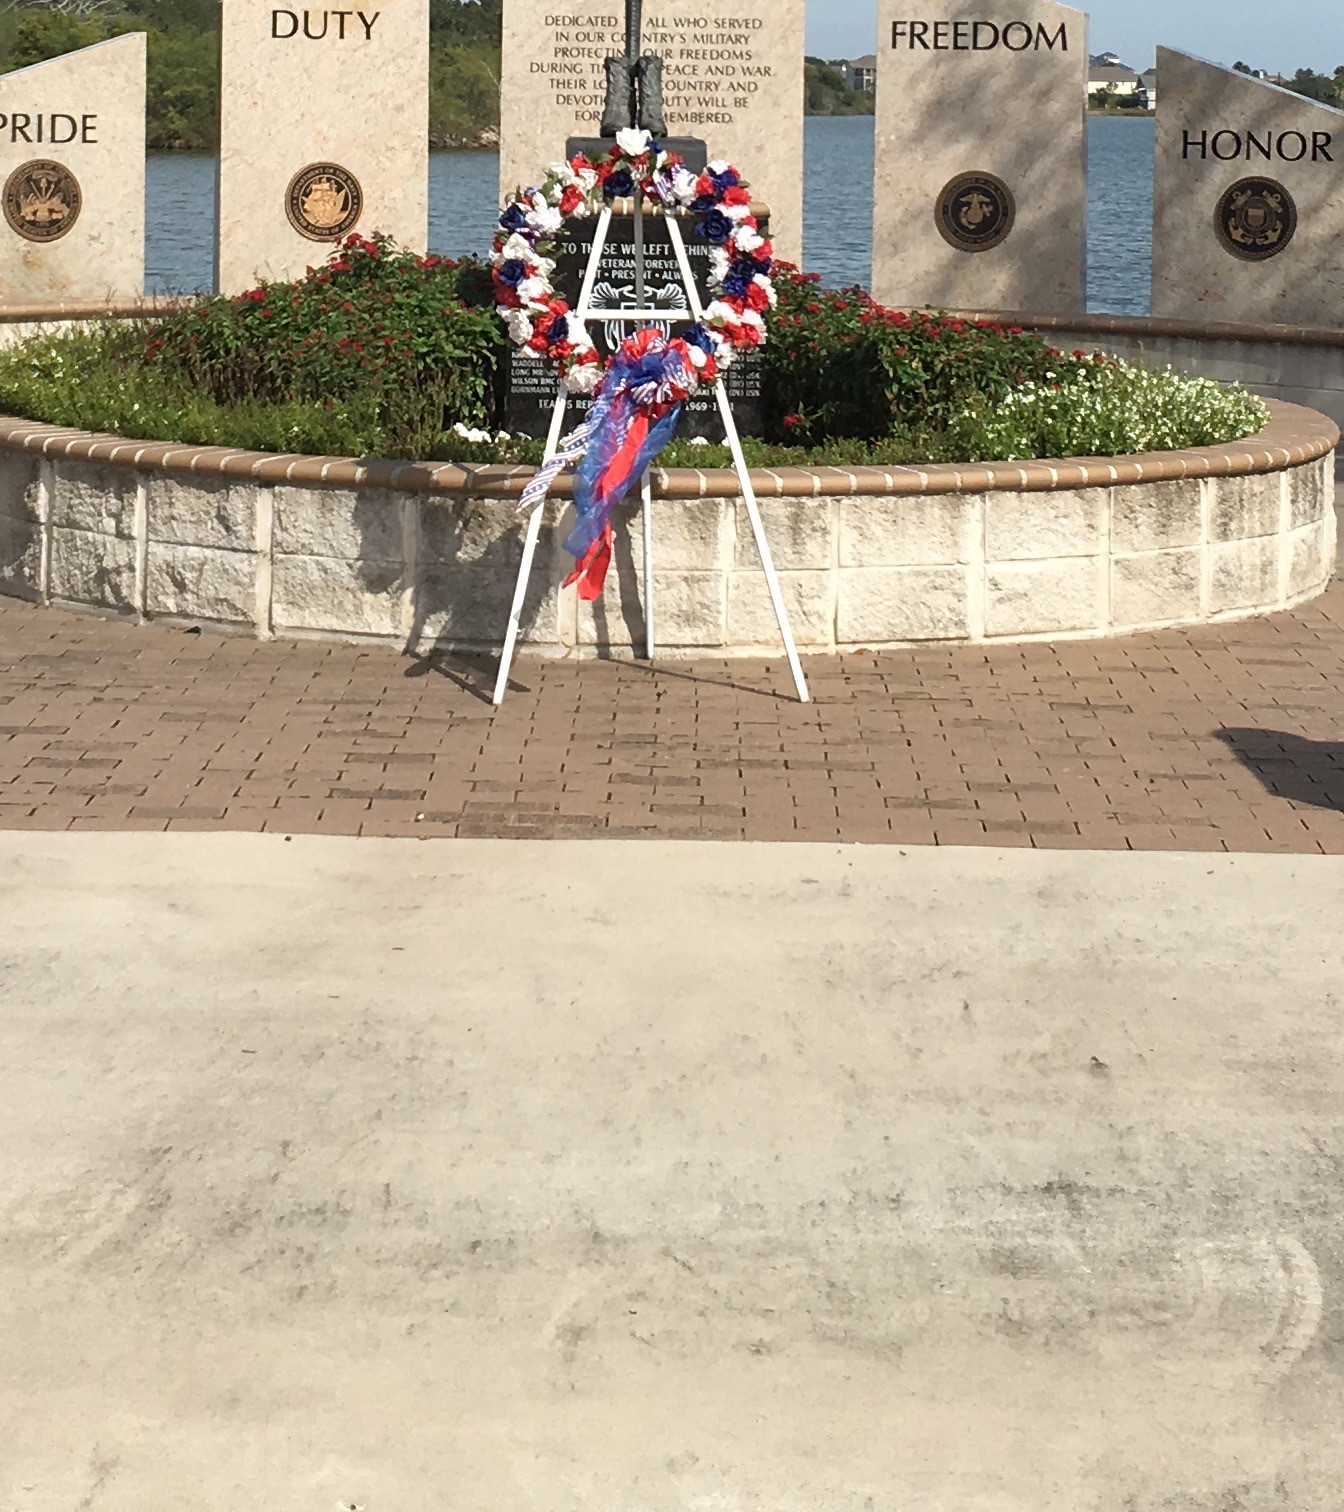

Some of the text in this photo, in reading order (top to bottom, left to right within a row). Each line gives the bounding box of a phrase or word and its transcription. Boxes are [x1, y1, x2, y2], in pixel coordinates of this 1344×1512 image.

[272, 9, 381, 41] DUTY
[545, 15, 763, 29] DEDICATED ALL WHO SERVED
[555, 32, 569, 43] IN
[575, 32, 605, 43] OUR
[692, 33, 751, 45] MILITARY
[891, 20, 1068, 51] FREEDOM
[554, 47, 752, 60] PROTECTIN OUR FREEDOMS
[529, 62, 583, 74] DURING
[704, 64, 735, 76] AND
[549, 78, 587, 90] THEIR
[662, 79, 721, 91] OUNTRY
[728, 81, 758, 92] AND
[661, 96, 691, 107] UTY
[697, 96, 727, 108] WILL
[734, 97, 749, 108] BE
[1182, 129, 1334, 162] HONOR
[561, 242, 576, 255] TO
[581, 242, 617, 255] THSE
[643, 244, 669, 255] LEFT
[611, 270, 652, 280] PRESNT
[538, 399, 573, 409] TEAS
